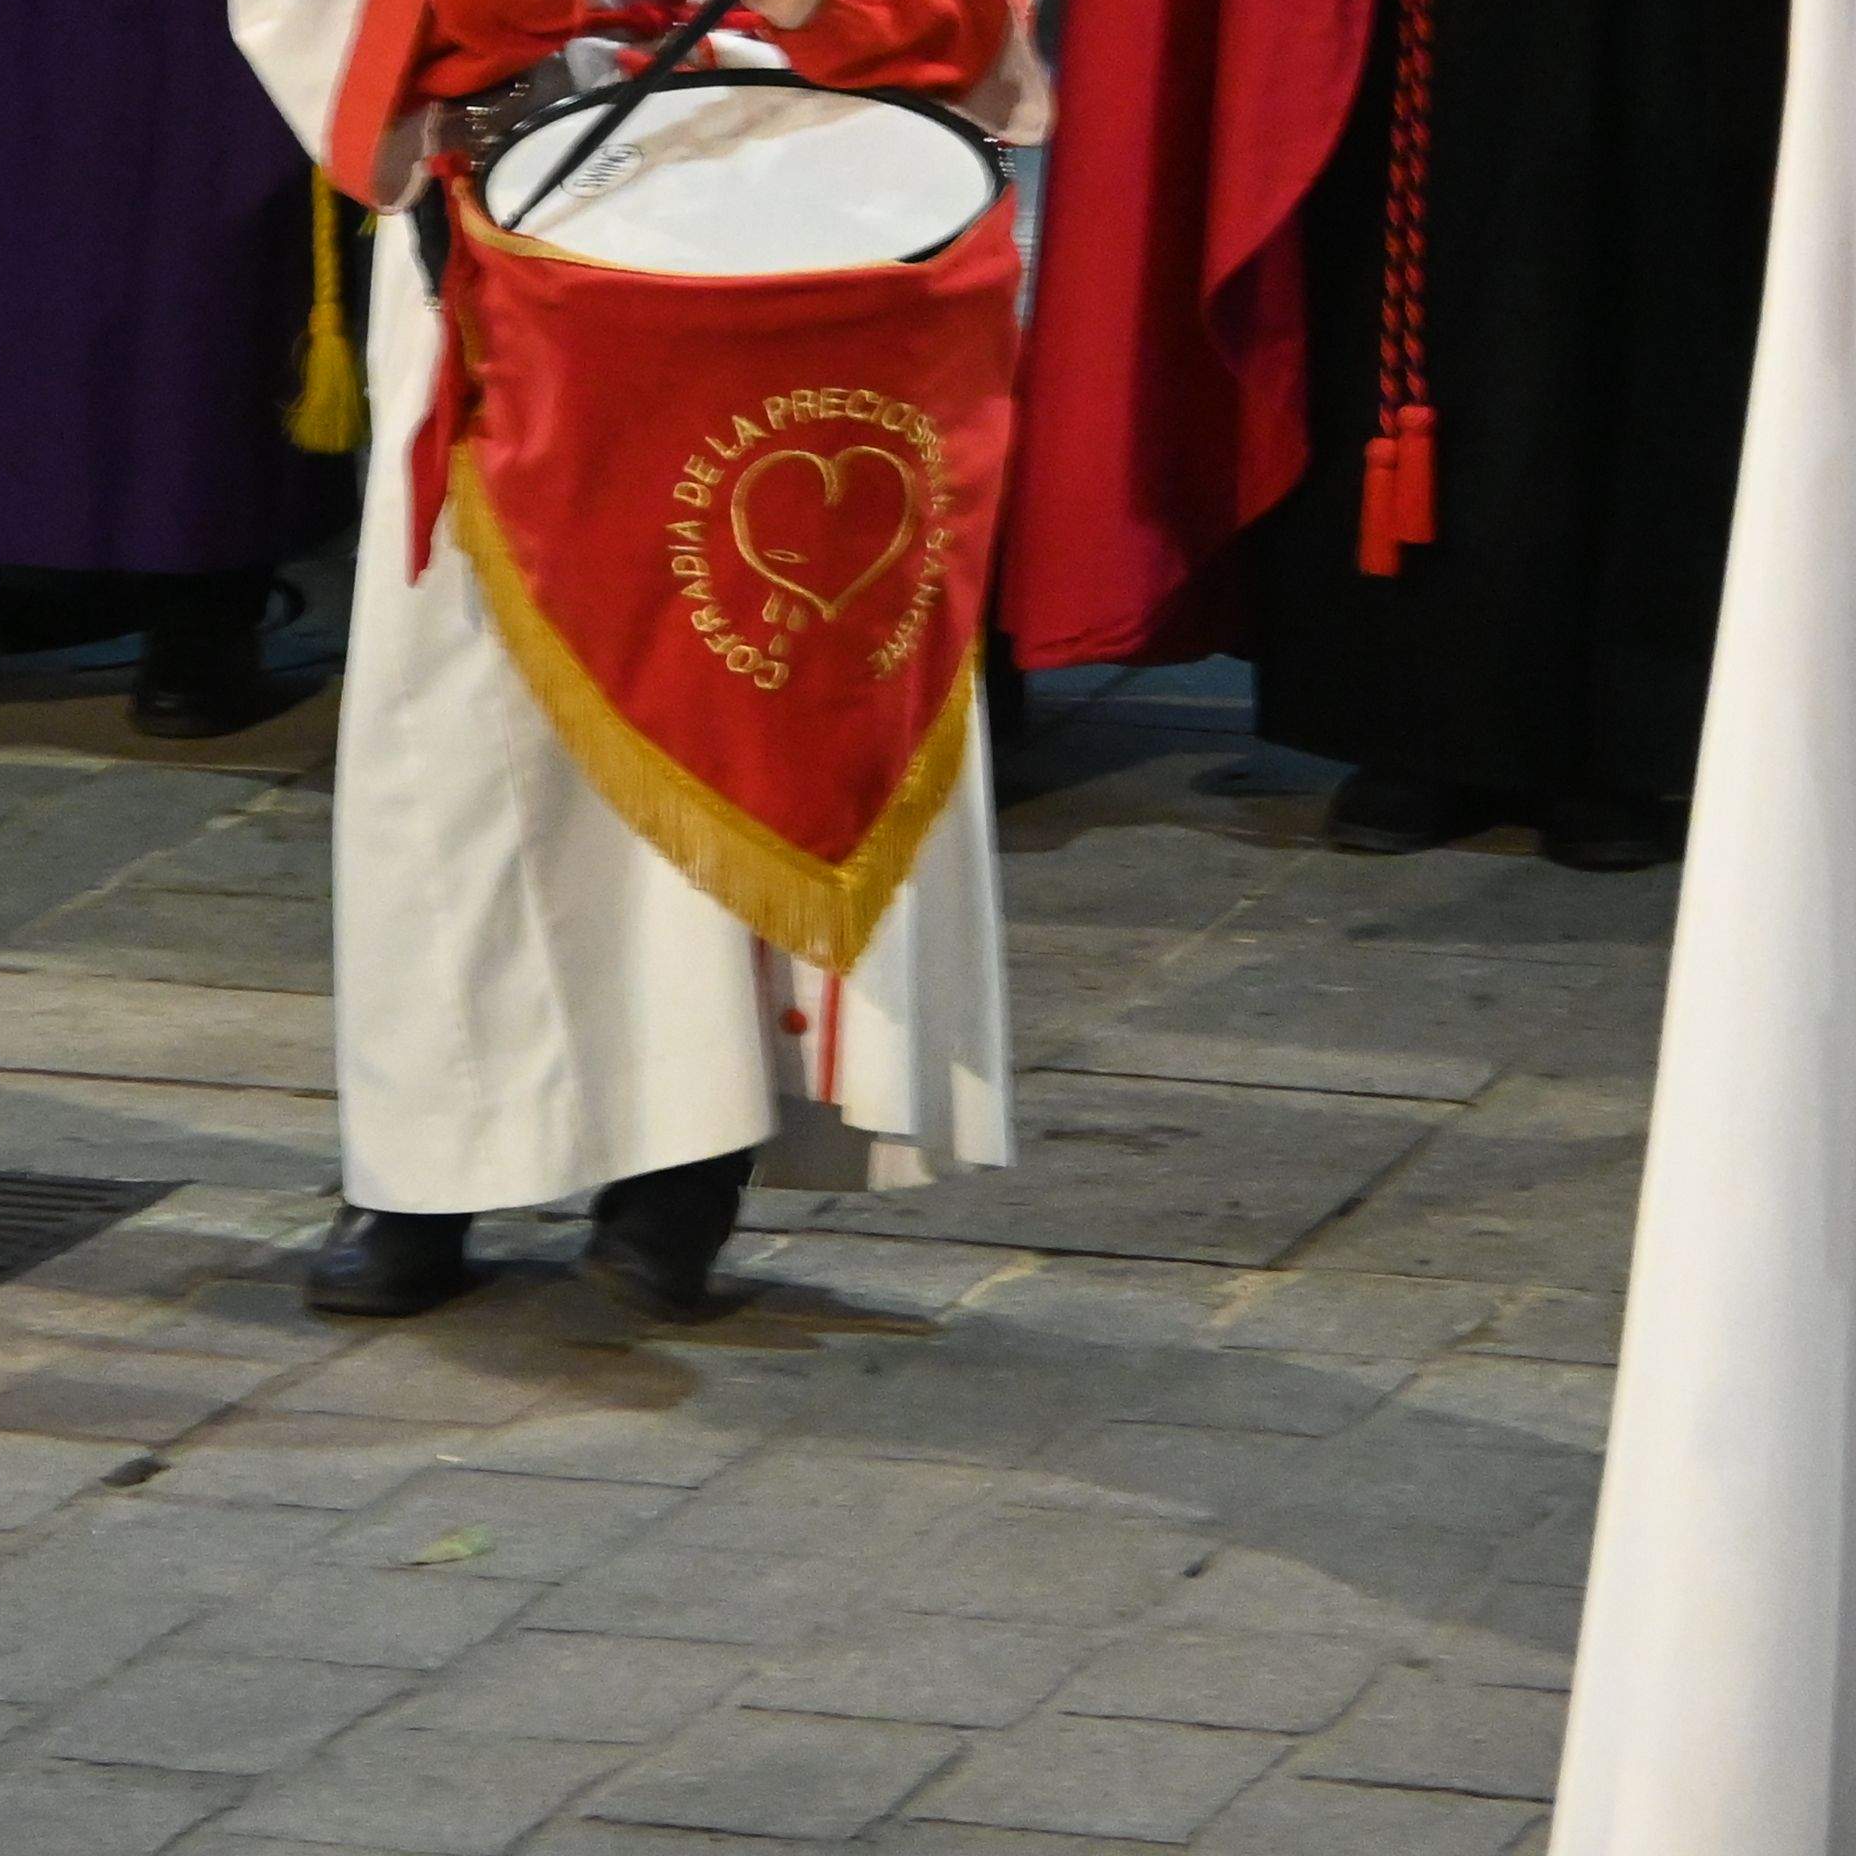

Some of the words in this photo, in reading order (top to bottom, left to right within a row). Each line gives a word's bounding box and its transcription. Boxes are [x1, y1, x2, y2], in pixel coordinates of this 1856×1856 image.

[572, 147, 634, 188] SWING
[704, 414, 772, 461] LA
[672, 453, 726, 509] DE
[664, 519, 789, 690] COFRADIA
